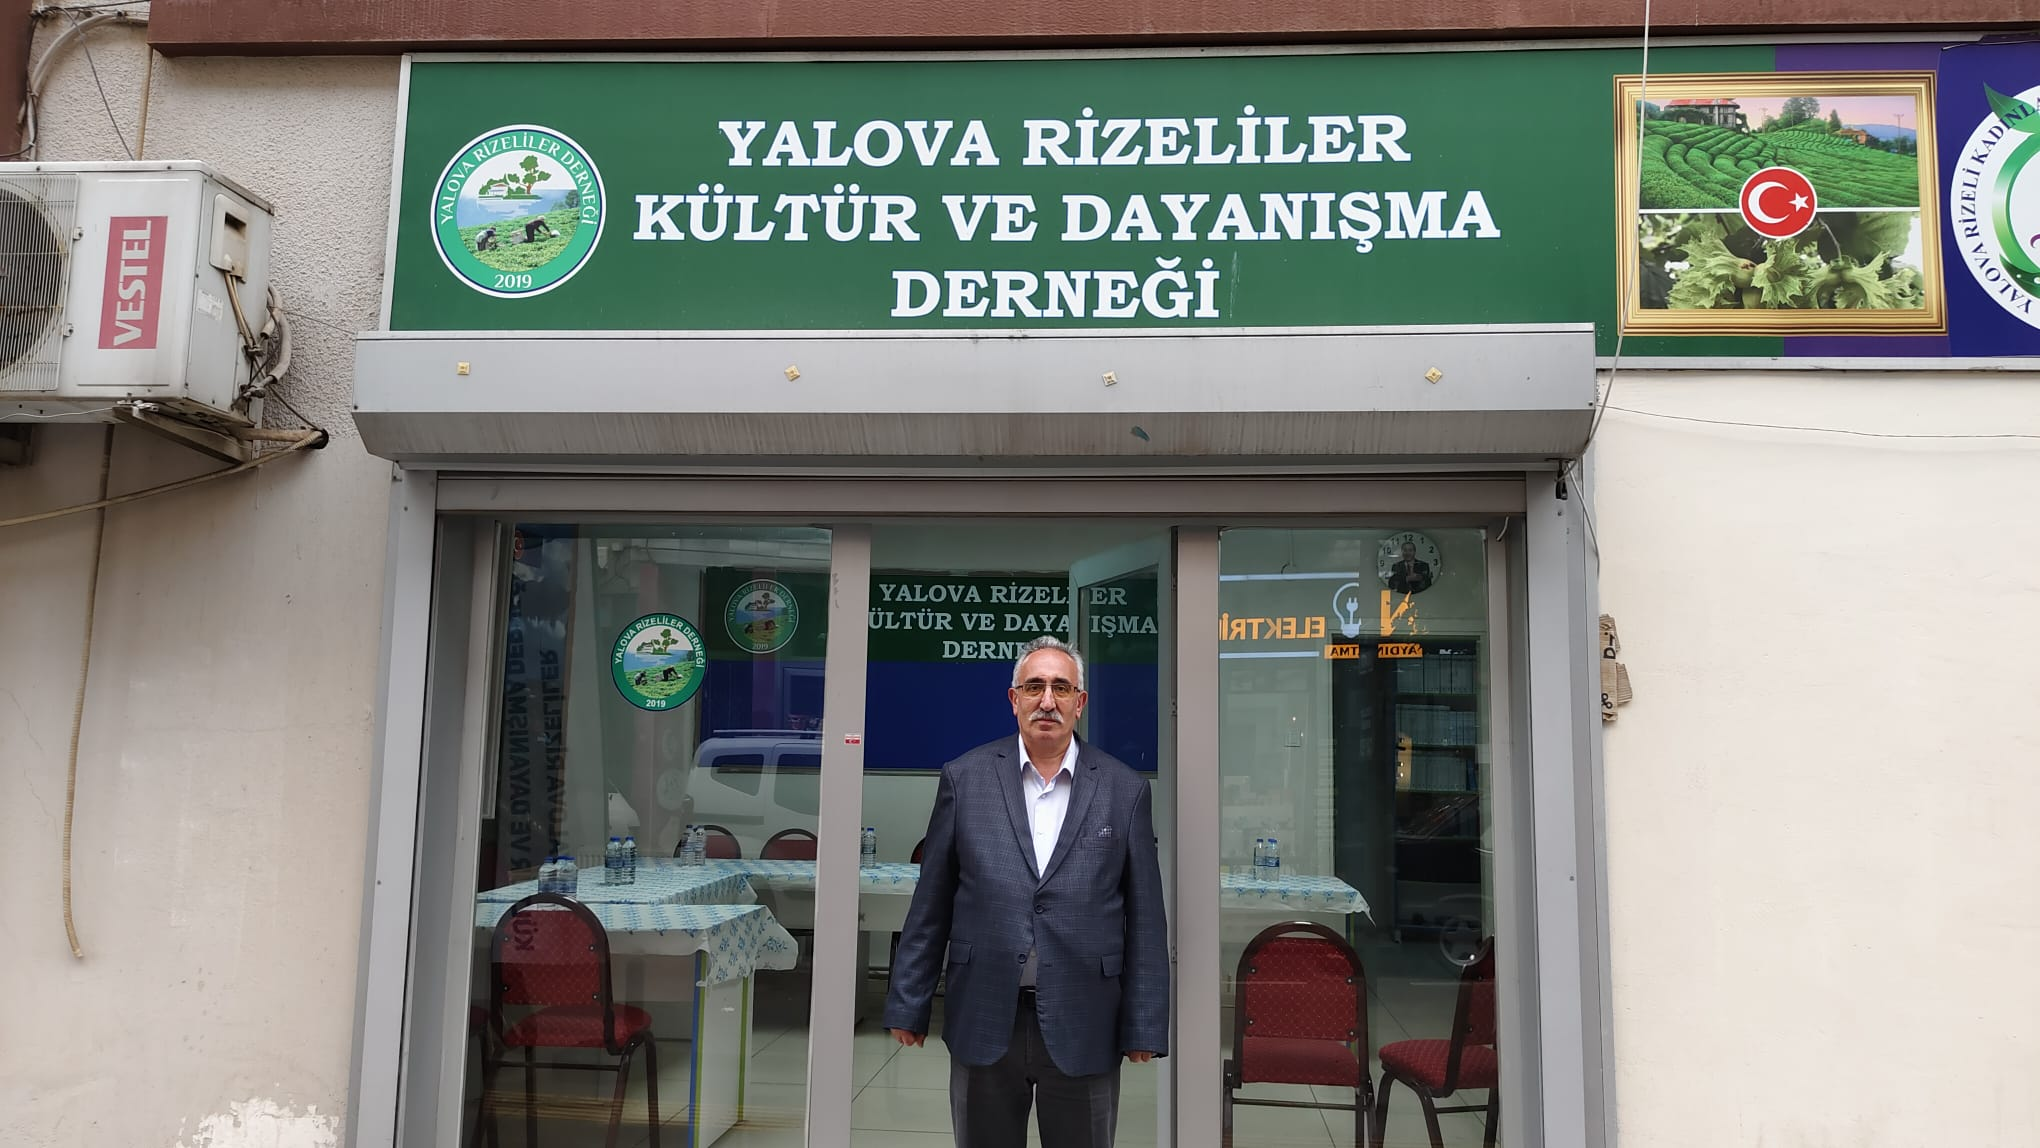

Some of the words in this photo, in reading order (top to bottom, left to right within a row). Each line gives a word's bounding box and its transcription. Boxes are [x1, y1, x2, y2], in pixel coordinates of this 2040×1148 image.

[718, 119, 1001, 167] YALOVA
[1022, 104, 1412, 166] RİZELİLER
[440, 161, 475, 225] YALOVA
[473, 132, 560, 162] RİZELİLER
[560, 151, 599, 225] DERNEĞİ
[1958, 167, 1981, 239] RİZELİ
[632, 183, 921, 242] KÜLTÜR
[941, 194, 1039, 242] VE
[1060, 190, 1501, 254] DAYANIŞMA
[112, 219, 152, 347] VESTEL
[494, 274, 532, 289] 2019
[890, 255, 1221, 319] DERNEĞİ
[1971, 242, 2034, 314] YALOVA
[868, 607, 953, 631] ÜLTÜR
[961, 612, 996, 632] VE
[1004, 614, 1159, 639] DAYAIŞMA
[878, 583, 982, 604] YALOVA
[989, 581, 1128, 606] RİZELER
[614, 629, 637, 665] YALOVA
[635, 615, 684, 629] RİZELİLER
[645, 699, 666, 708] 2019
